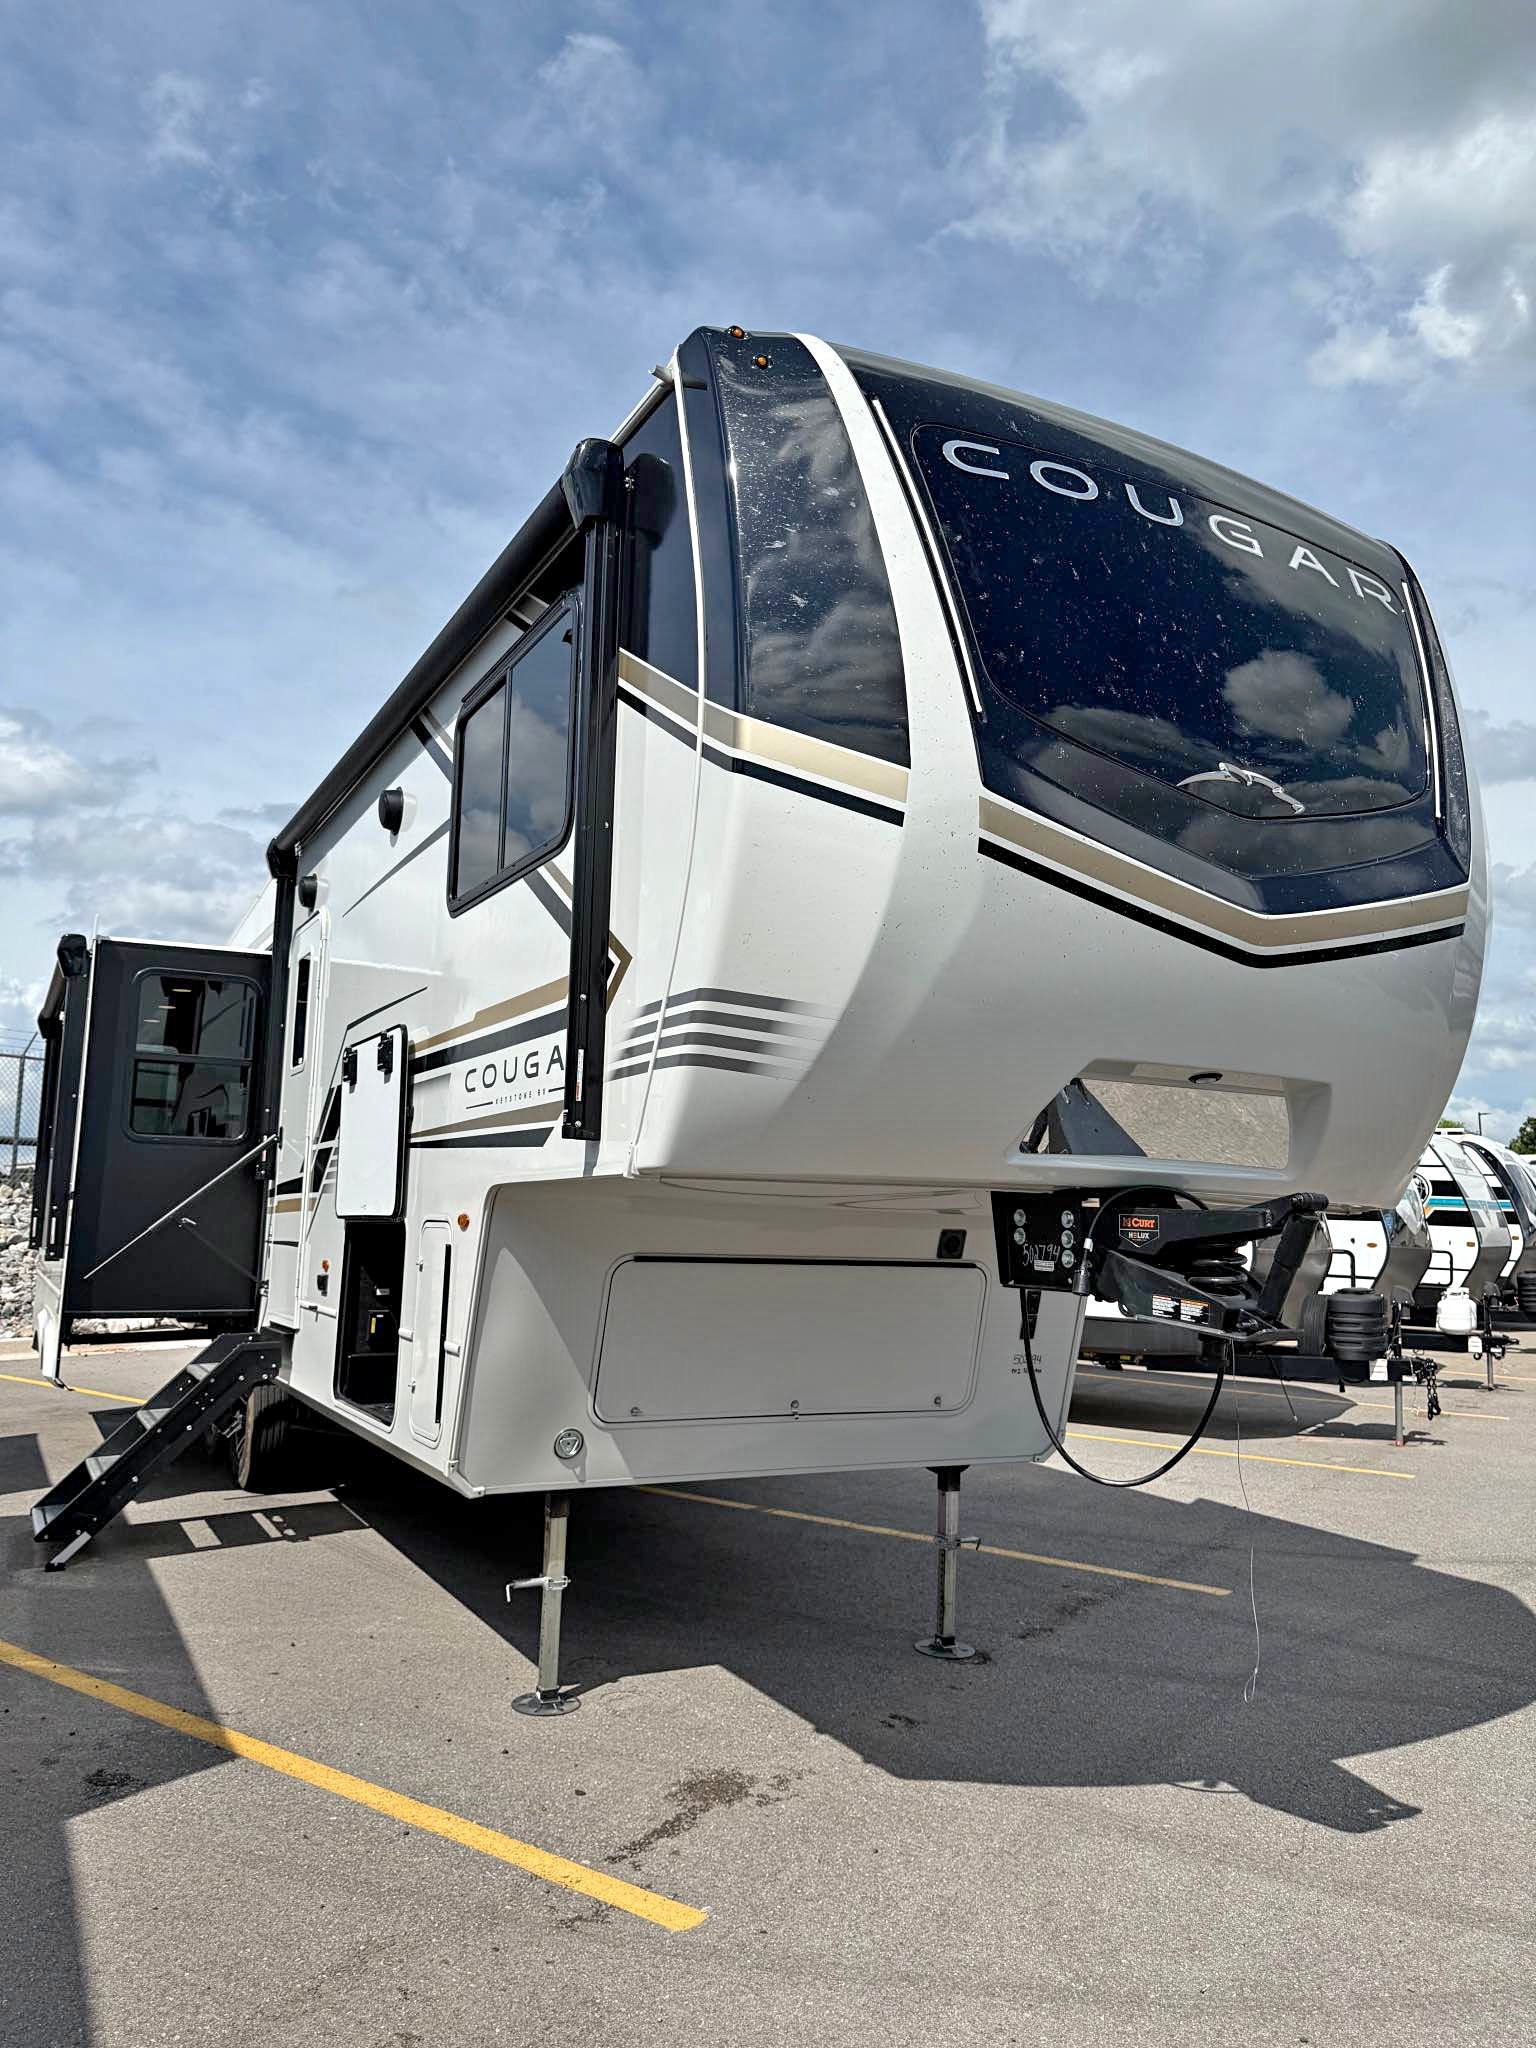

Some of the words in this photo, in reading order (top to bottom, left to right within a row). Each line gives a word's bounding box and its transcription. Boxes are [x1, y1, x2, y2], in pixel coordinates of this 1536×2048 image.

[942, 439, 1399, 615] COUGAR
[465, 1044, 565, 1093] COUGA
[1132, 1217, 1155, 1228] CURT
